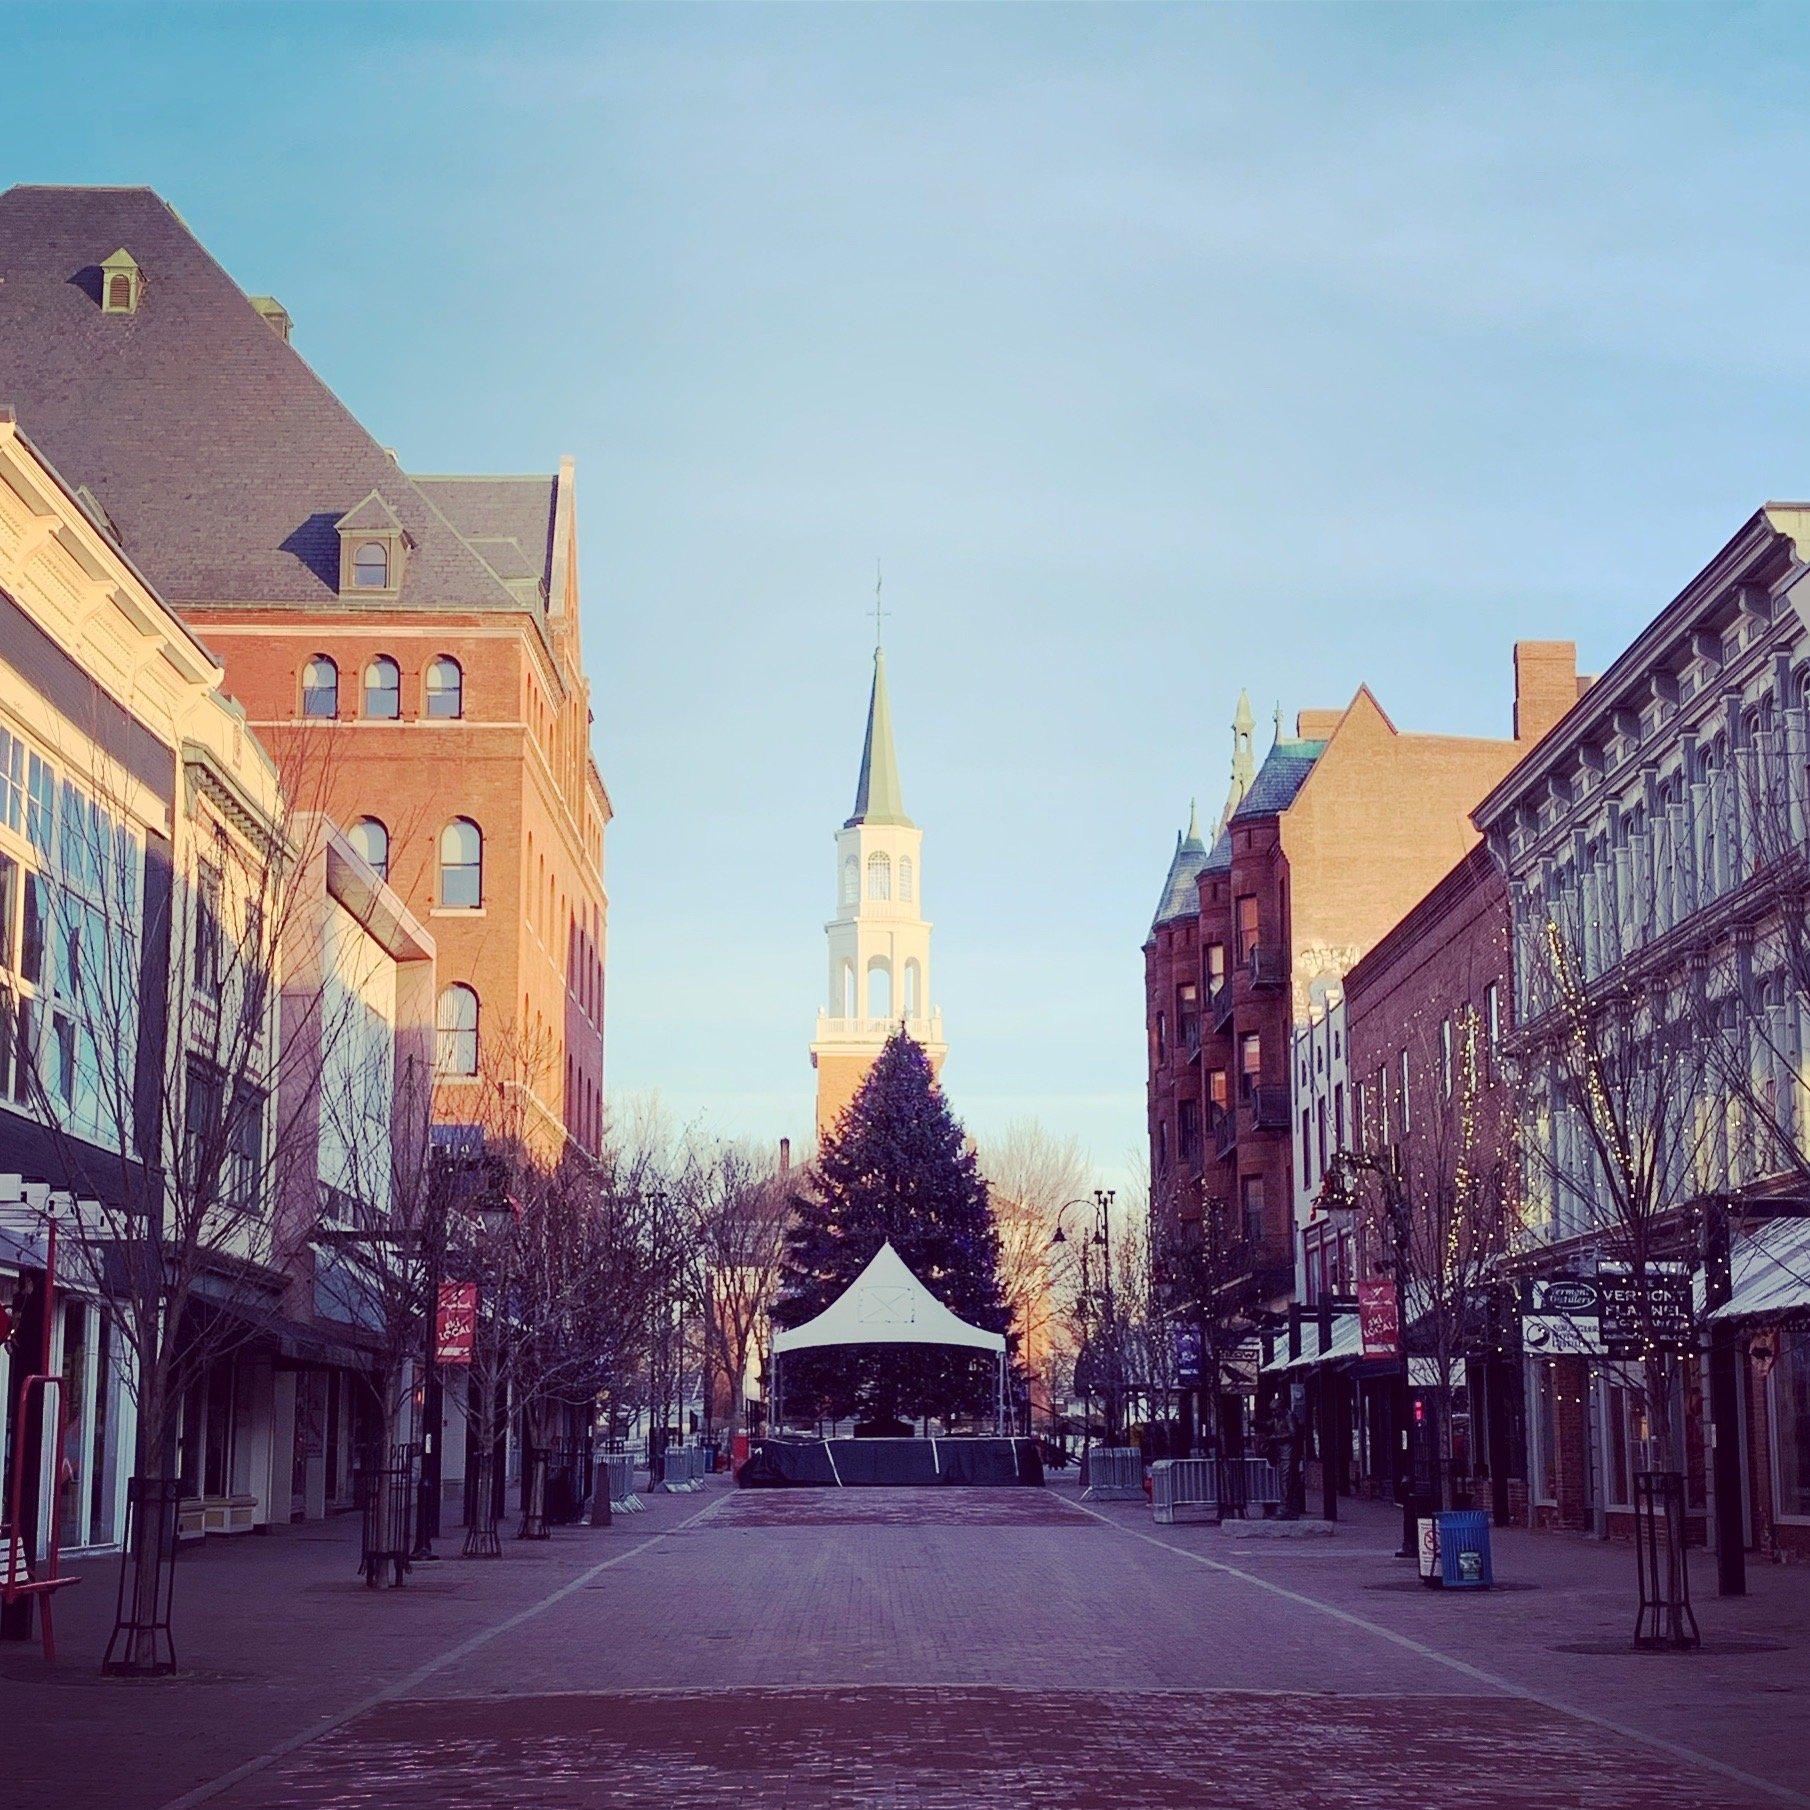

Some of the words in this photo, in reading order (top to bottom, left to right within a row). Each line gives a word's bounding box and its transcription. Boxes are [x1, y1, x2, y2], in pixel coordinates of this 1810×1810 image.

[1602, 1290, 1686, 1302] VERONT
[1604, 1305, 1686, 1316] FLANEL
[1619, 1319, 1672, 1328] COMANY
[438, 1324, 472, 1341] LOCAL
